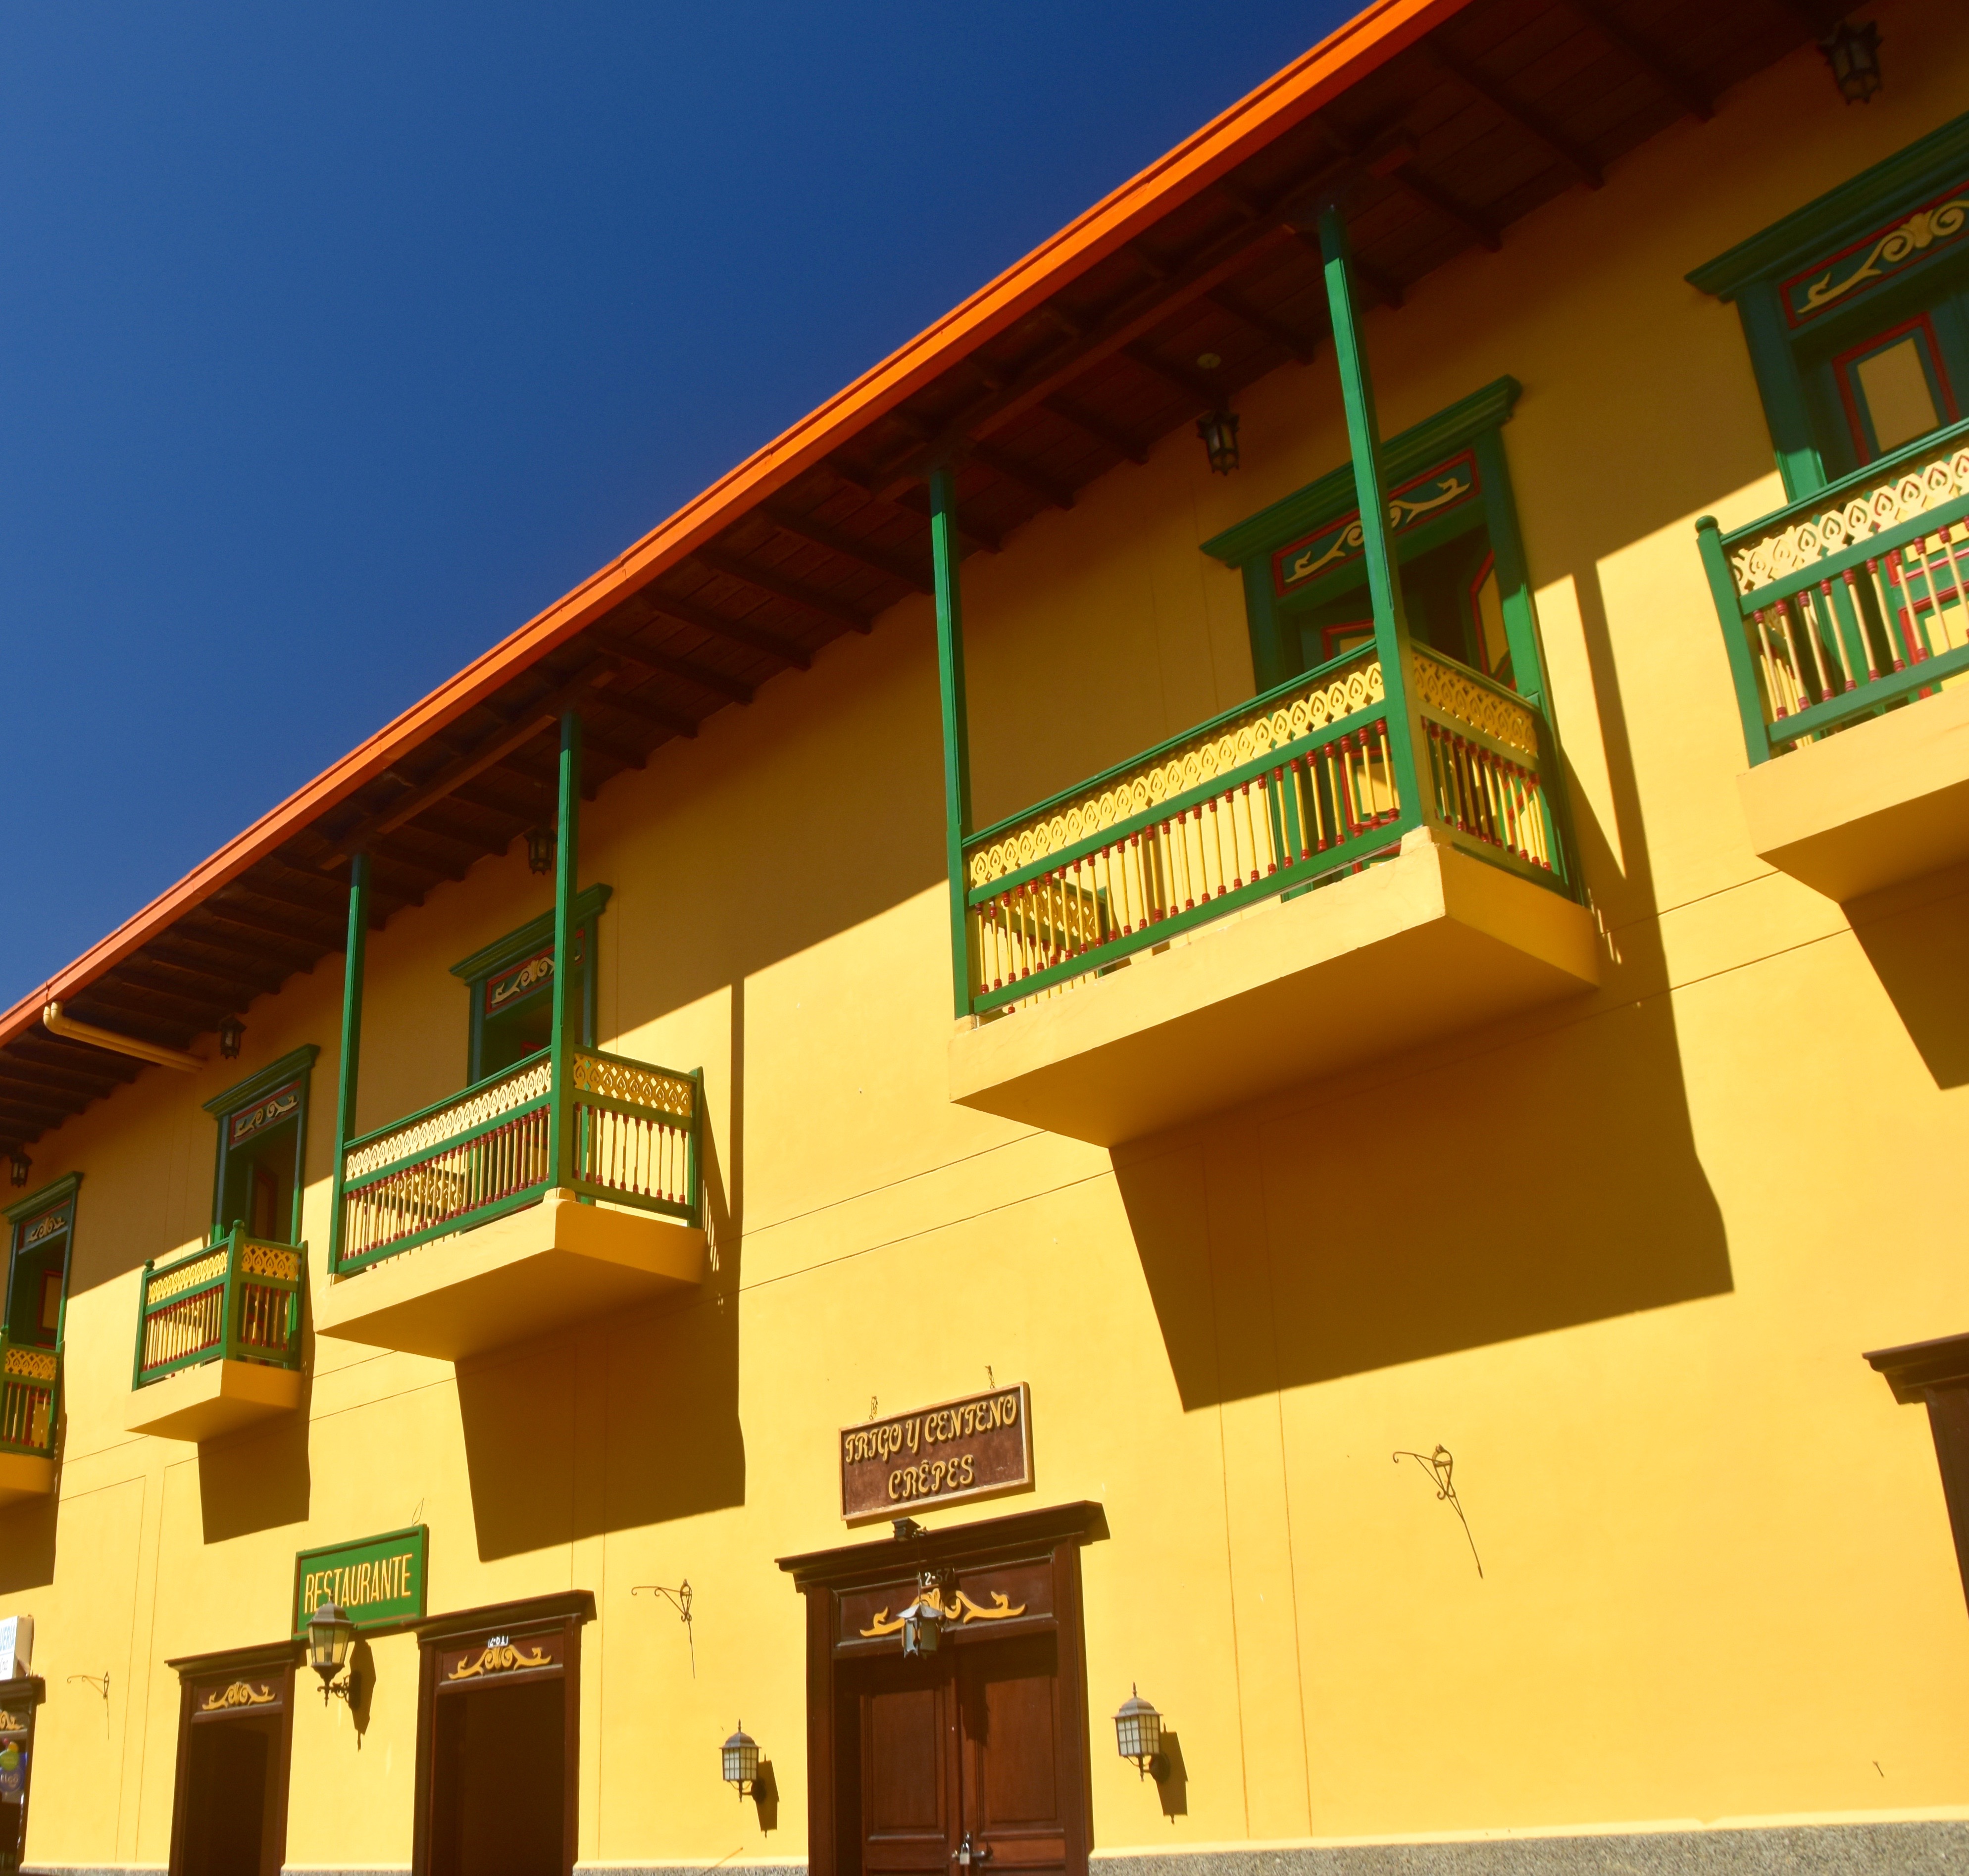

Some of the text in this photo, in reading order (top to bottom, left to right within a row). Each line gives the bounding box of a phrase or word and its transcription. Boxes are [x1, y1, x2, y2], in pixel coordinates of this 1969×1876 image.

[845, 1395, 1017, 1462] TRIGO Y CENTENO
[889, 1454, 974, 1499] CRÊPES
[304, 1553, 413, 1614] RESTAURANTE
